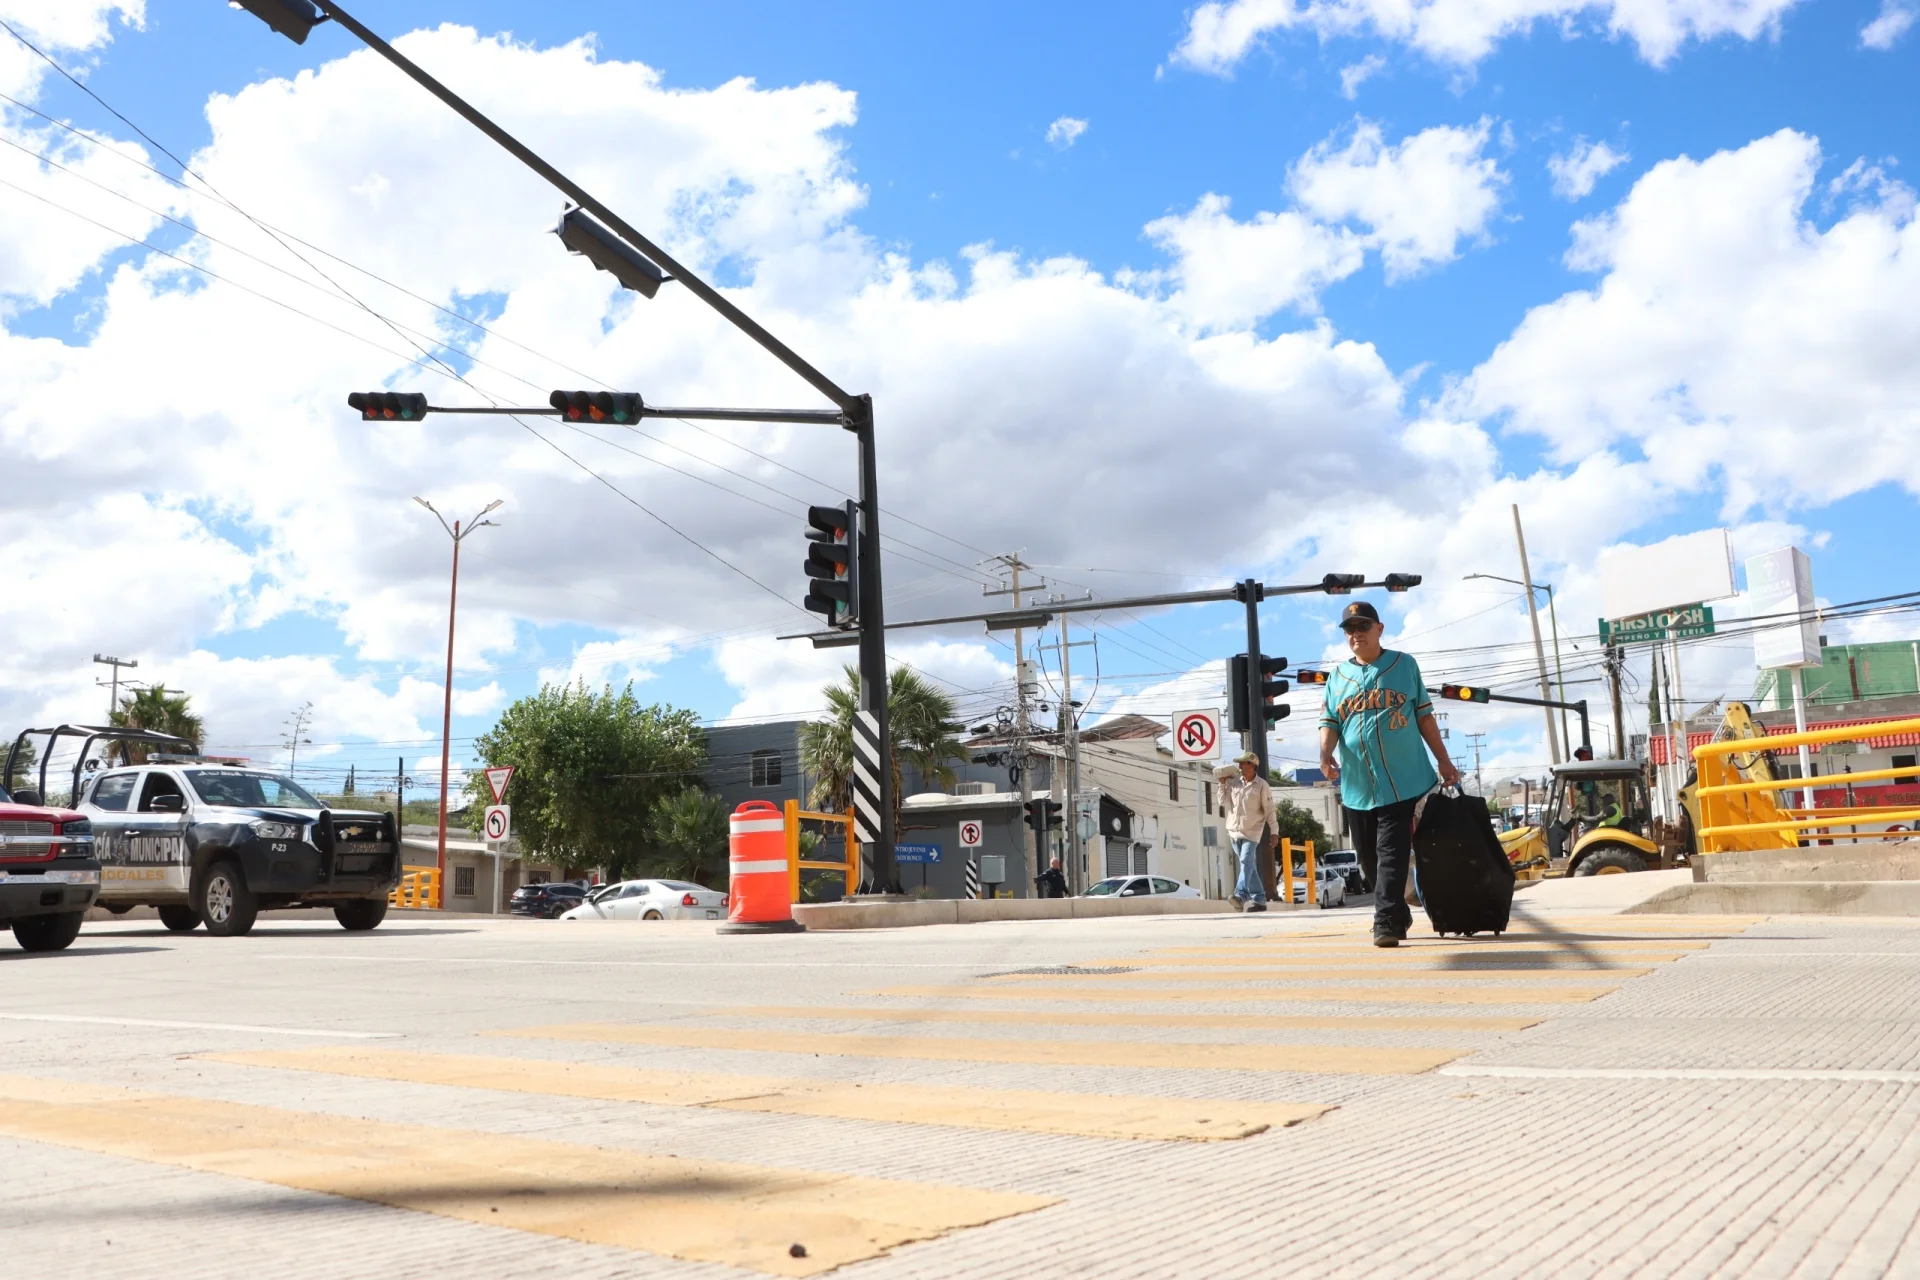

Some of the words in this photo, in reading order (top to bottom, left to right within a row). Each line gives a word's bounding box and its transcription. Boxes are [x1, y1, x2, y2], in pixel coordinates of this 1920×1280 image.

[1349, 604, 1359, 615] T
[1609, 614, 1654, 633] FIRST
[1656, 608, 1704, 628] CSH
[1614, 632, 1650, 642] MPEÑO
[1655, 631, 1660, 639] Y
[1336, 688, 1407, 720] TIGRES
[1388, 710, 1408, 730] 26
[271, 842, 287, 852] P-23
